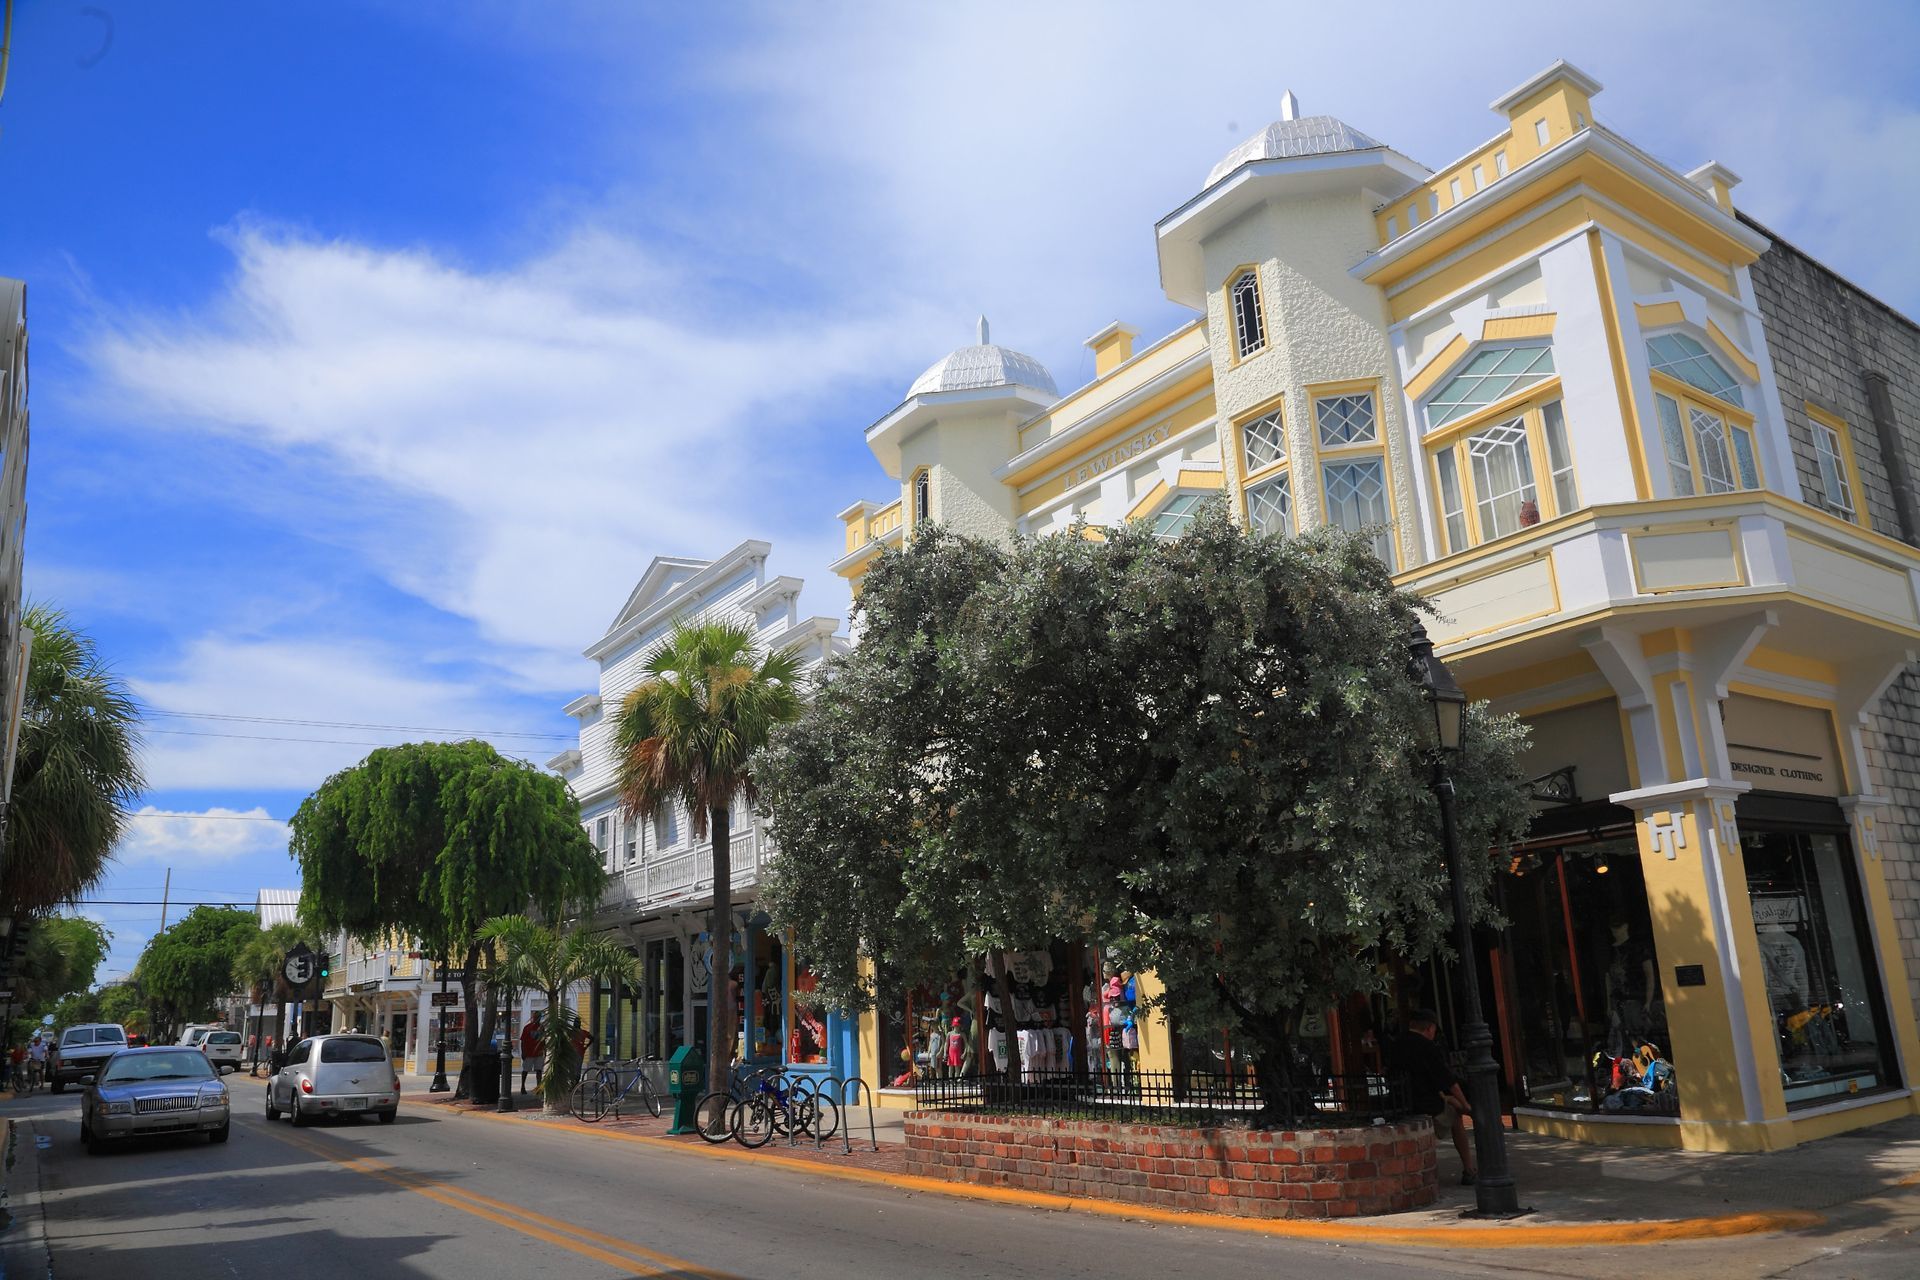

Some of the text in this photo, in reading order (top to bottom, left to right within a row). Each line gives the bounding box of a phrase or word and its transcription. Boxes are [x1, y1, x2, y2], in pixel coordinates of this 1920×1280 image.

[1064, 421, 1172, 491] LEWINSKY
[1730, 762, 1823, 781] DESIGNER CLOTHING
